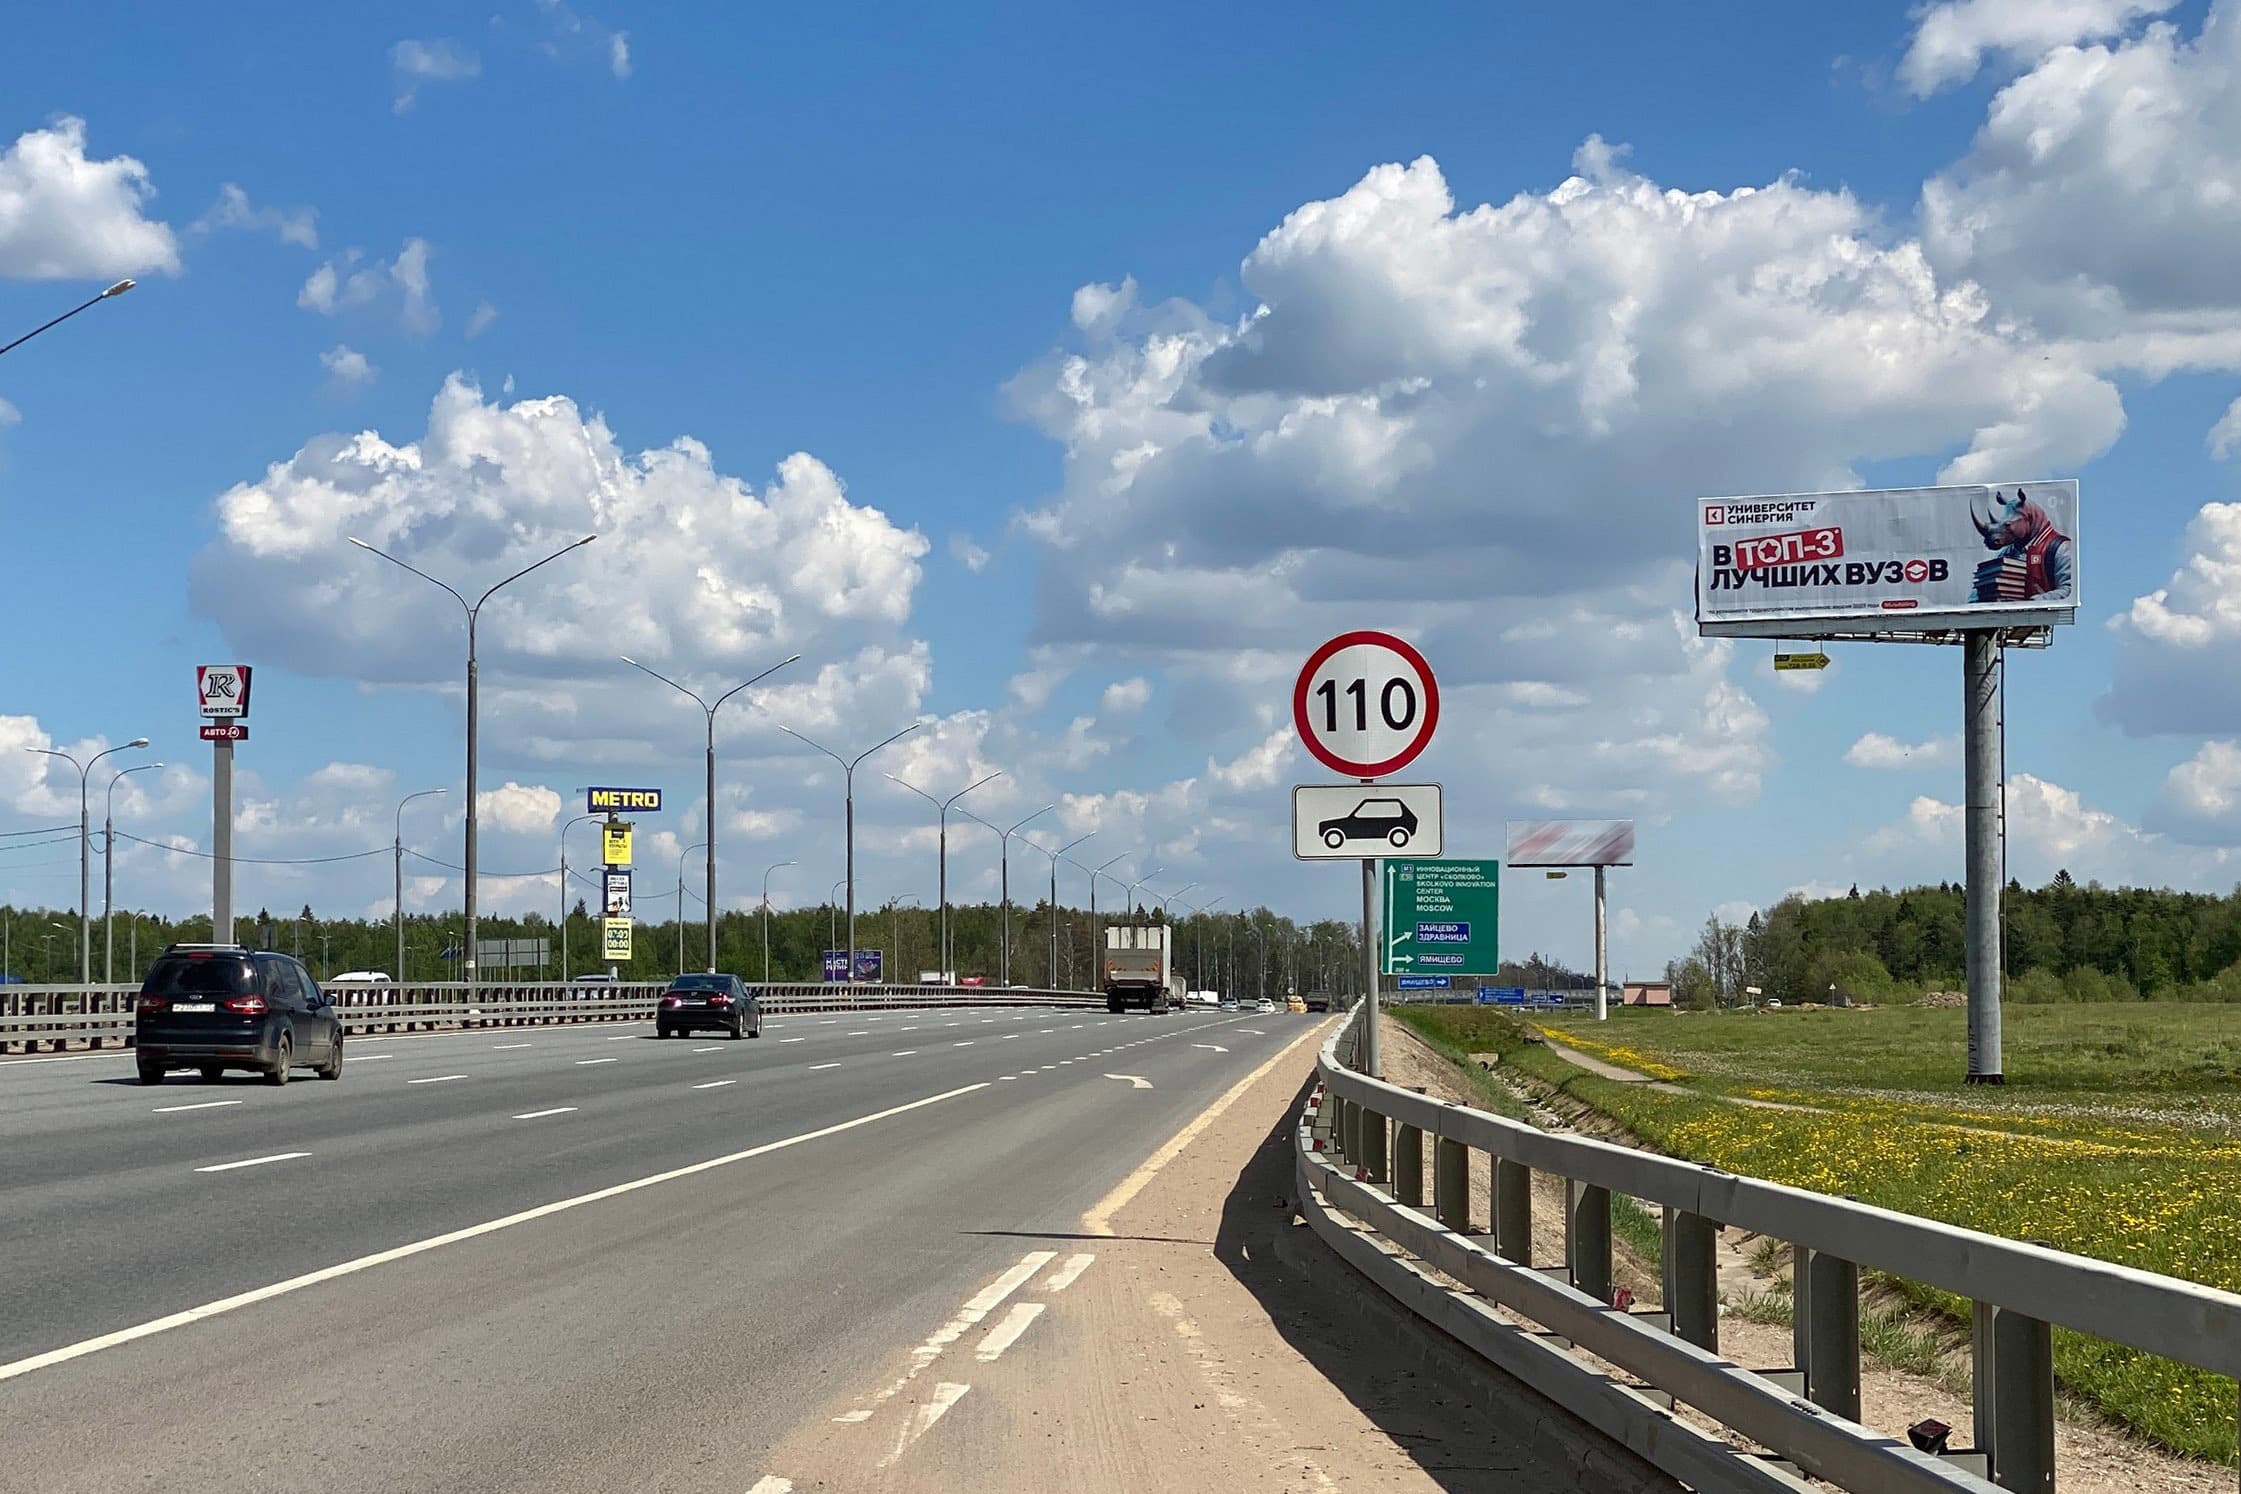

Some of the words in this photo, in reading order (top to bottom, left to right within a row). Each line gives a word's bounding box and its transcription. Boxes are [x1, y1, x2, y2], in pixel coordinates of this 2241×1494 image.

[1727, 501, 1816, 514] УНИВЕРСИТЕТ
[1727, 513, 1794, 525] СИНЕРГИЯ
[1713, 545, 1731, 566] В
[1710, 564, 1841, 590] ЛУЧШИХ
[1845, 559, 1949, 586] ВУЗОВ
[205, 673, 235, 698] R
[1316, 677, 1417, 732] 110
[204, 728, 226, 736] АВТО
[592, 791, 659, 808] METRO
[1418, 923, 1458, 933] ЗАЙЦЕВО
[1418, 933, 1468, 941] ЗДРАВНИЦА
[1419, 955, 1463, 964] ЯМИЩЕВО
